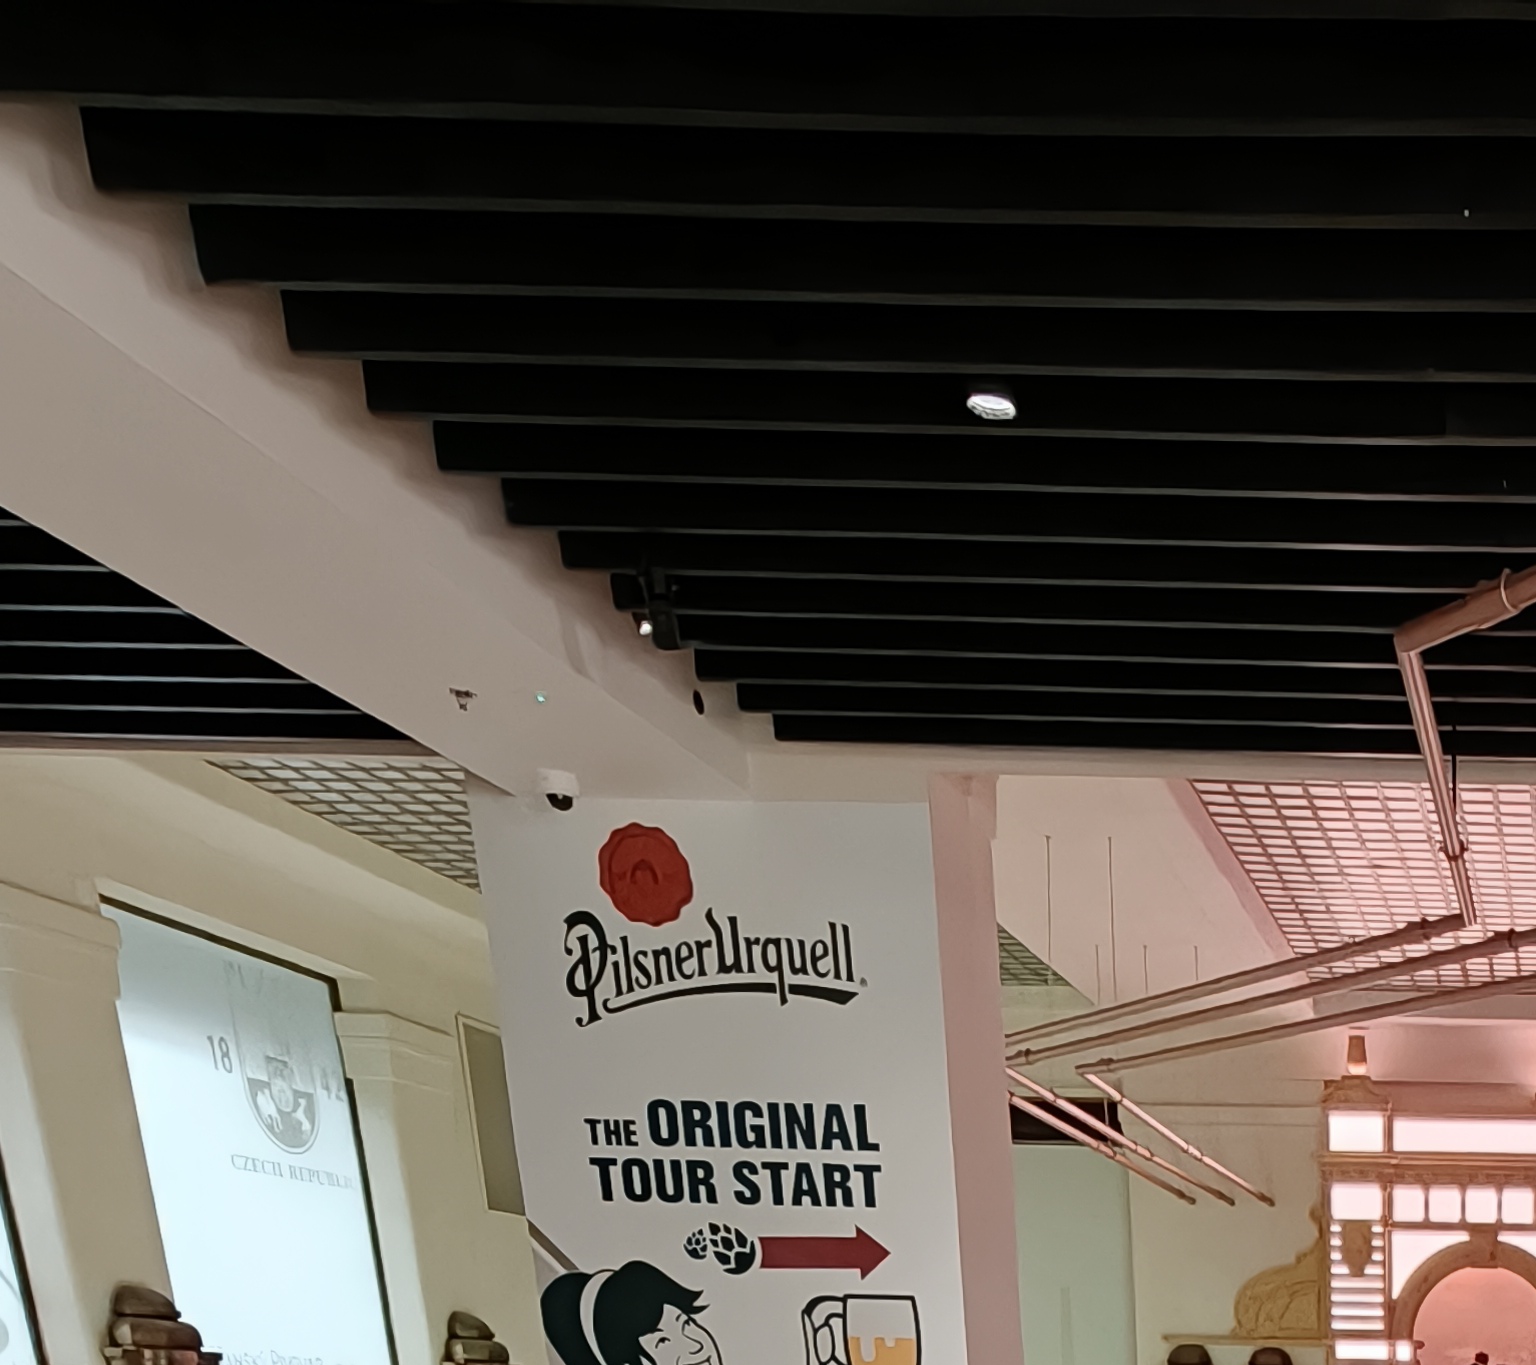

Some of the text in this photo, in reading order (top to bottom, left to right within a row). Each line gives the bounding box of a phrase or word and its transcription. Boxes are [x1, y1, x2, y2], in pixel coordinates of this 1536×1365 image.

[563, 906, 857, 1028] Pilsner Urquell
[206, 1035, 234, 1074] 18
[583, 1098, 881, 1153] THE ORIGINAL
[588, 1156, 882, 1209] TOUR START
